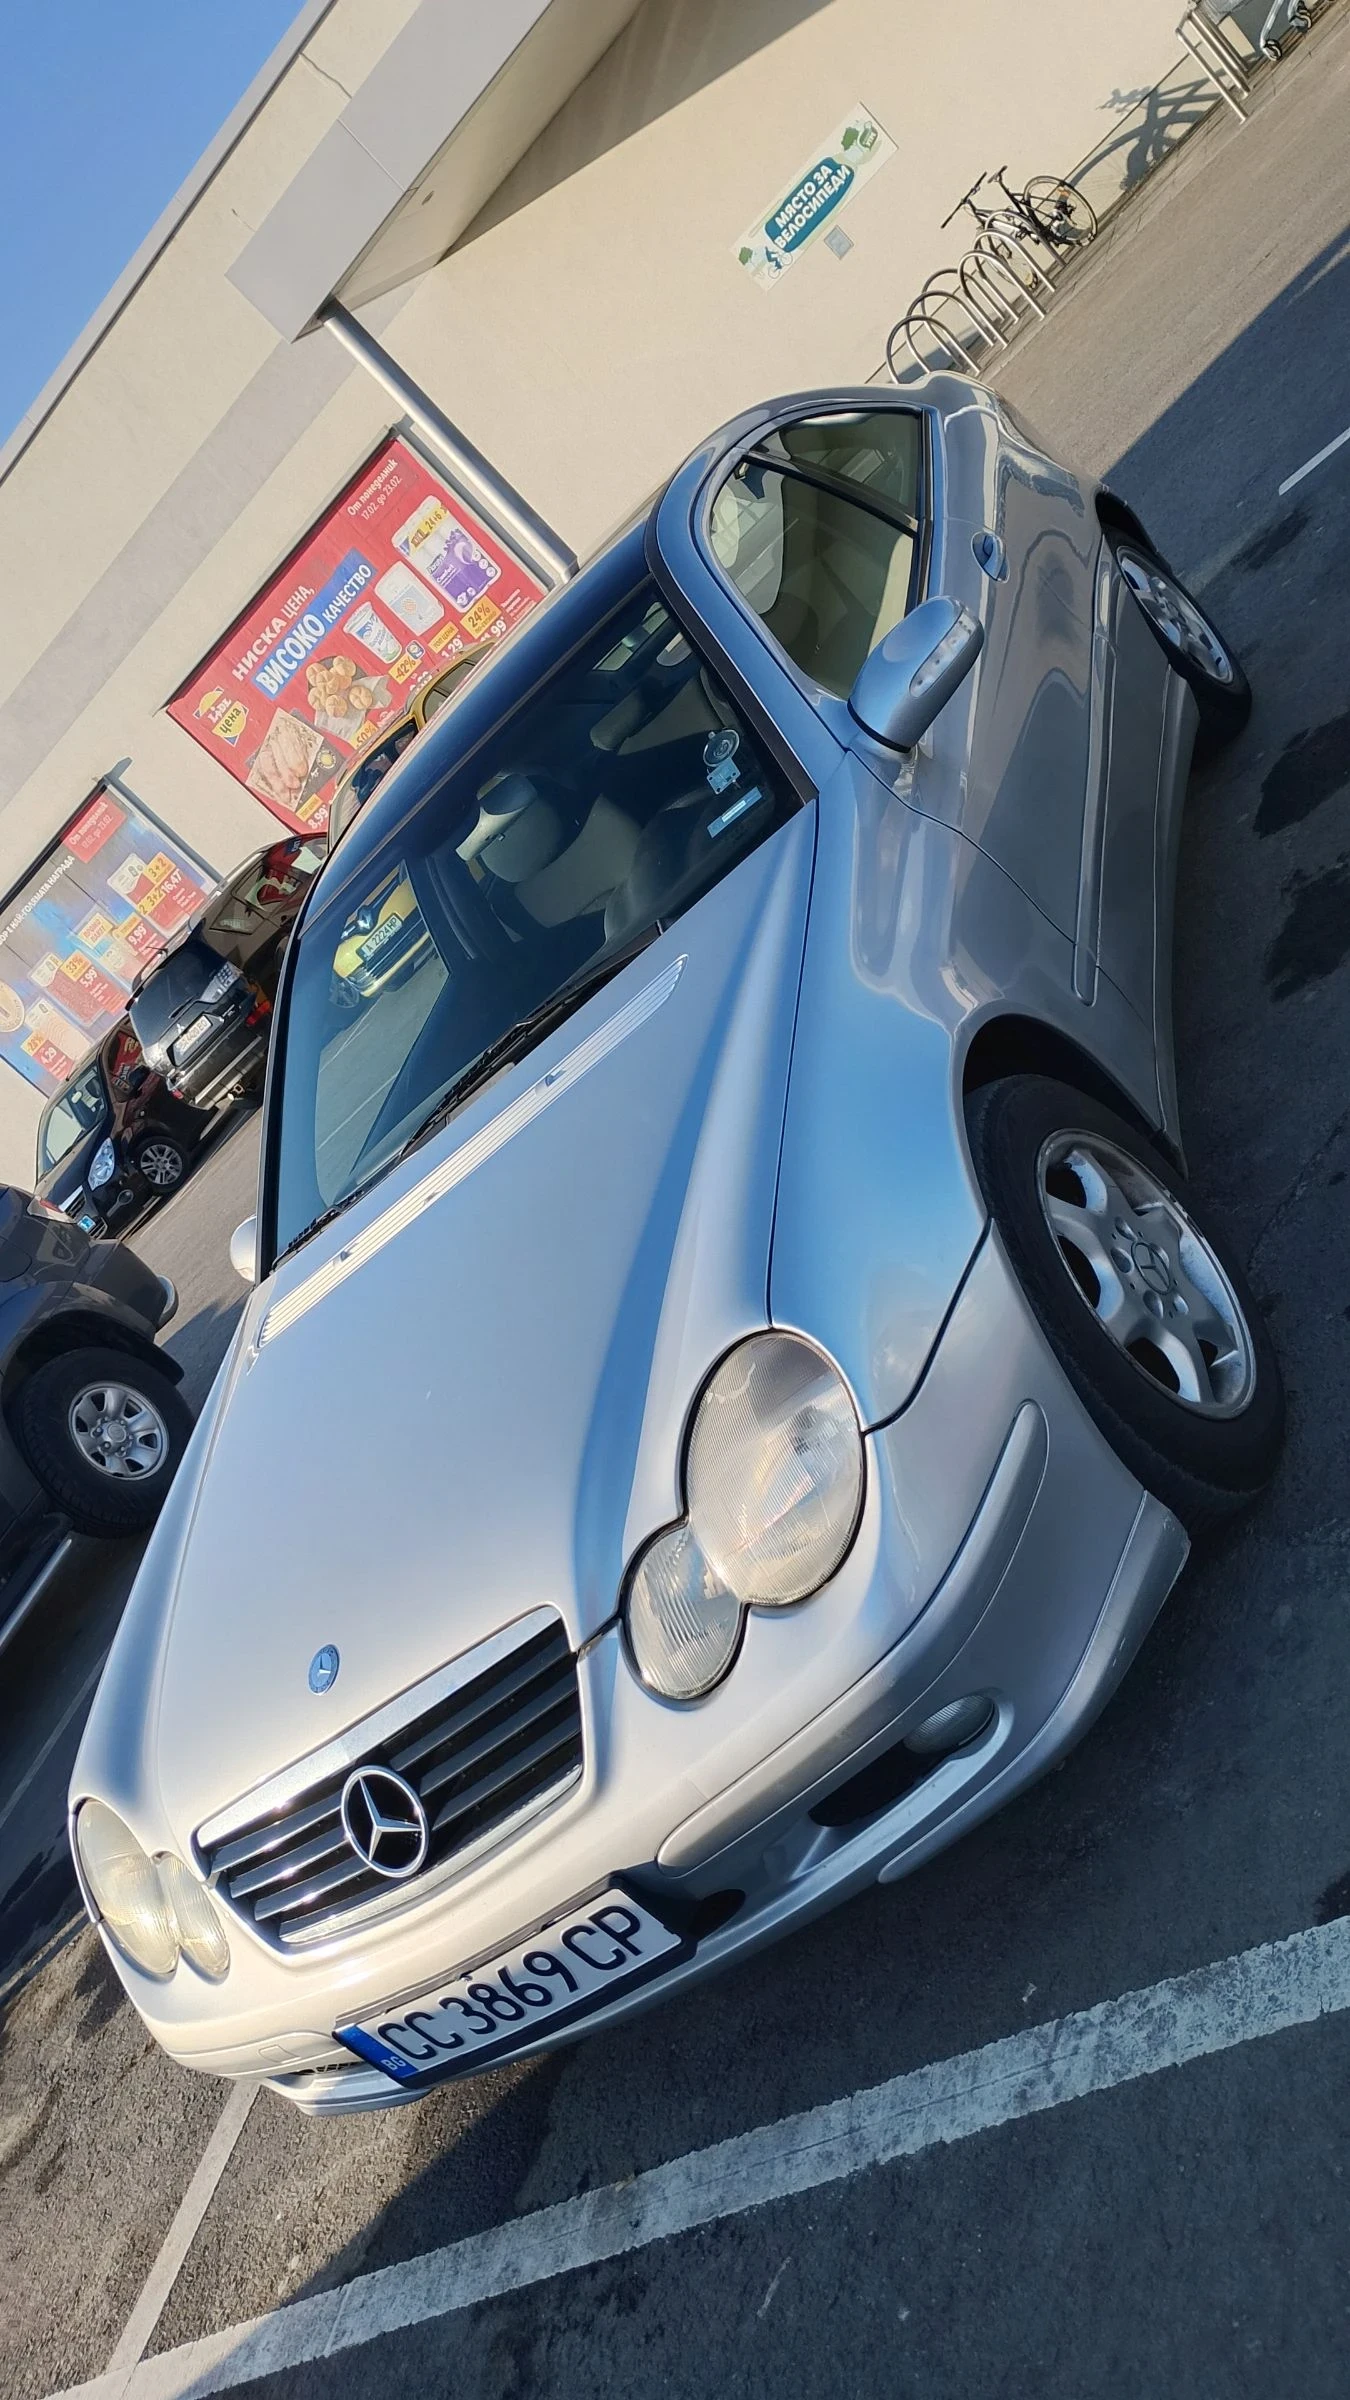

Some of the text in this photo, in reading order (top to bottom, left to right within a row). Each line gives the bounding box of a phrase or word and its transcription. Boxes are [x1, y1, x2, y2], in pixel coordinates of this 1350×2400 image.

[773, 163, 833, 229] МЯСТО ЗА
[773, 163, 850, 249] ВЕЛОСИПЕДИ
[346, 459, 398, 515] От понеделник
[375, 492, 389, 506] до
[230, 584, 315, 681] НИСКА ЦЕНА,
[254, 565, 370, 695] ВИСОКО КАЧЕСТВО
[465, 602, 491, 629] 24%
[391, 655, 417, 681] -42%
[218, 707, 241, 734] цена
[46, 854, 75, 886] НАГРАДА
[379, 1906, 642, 2059] CC 3869 CP
[382, 2053, 407, 2072] BG
